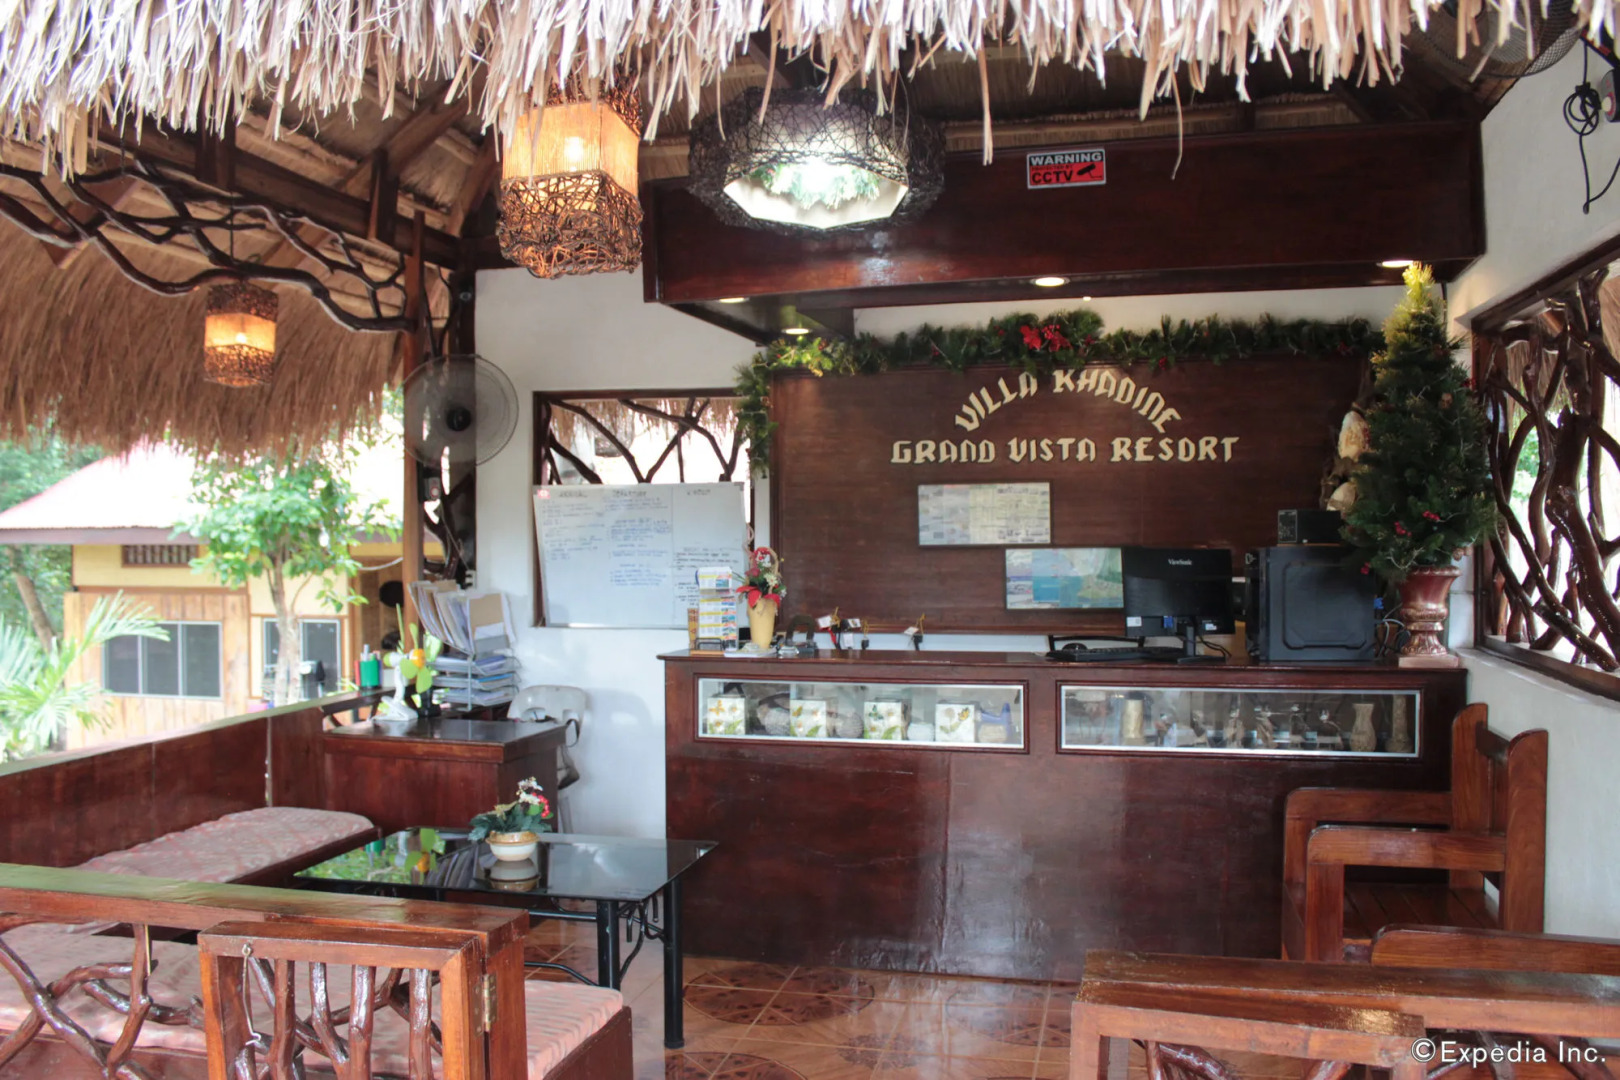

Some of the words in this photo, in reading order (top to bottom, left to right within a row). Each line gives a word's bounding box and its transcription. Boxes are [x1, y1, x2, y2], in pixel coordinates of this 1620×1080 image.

[1031, 152, 1102, 166] WARNING
[1032, 170, 1073, 183] CCTV
[955, 371, 1038, 432] VILLA
[1052, 369, 1182, 433] KHADINE
[890, 440, 996, 464] GRAND
[1007, 437, 1096, 462] VISTA
[1110, 436, 1240, 462] RESORT
